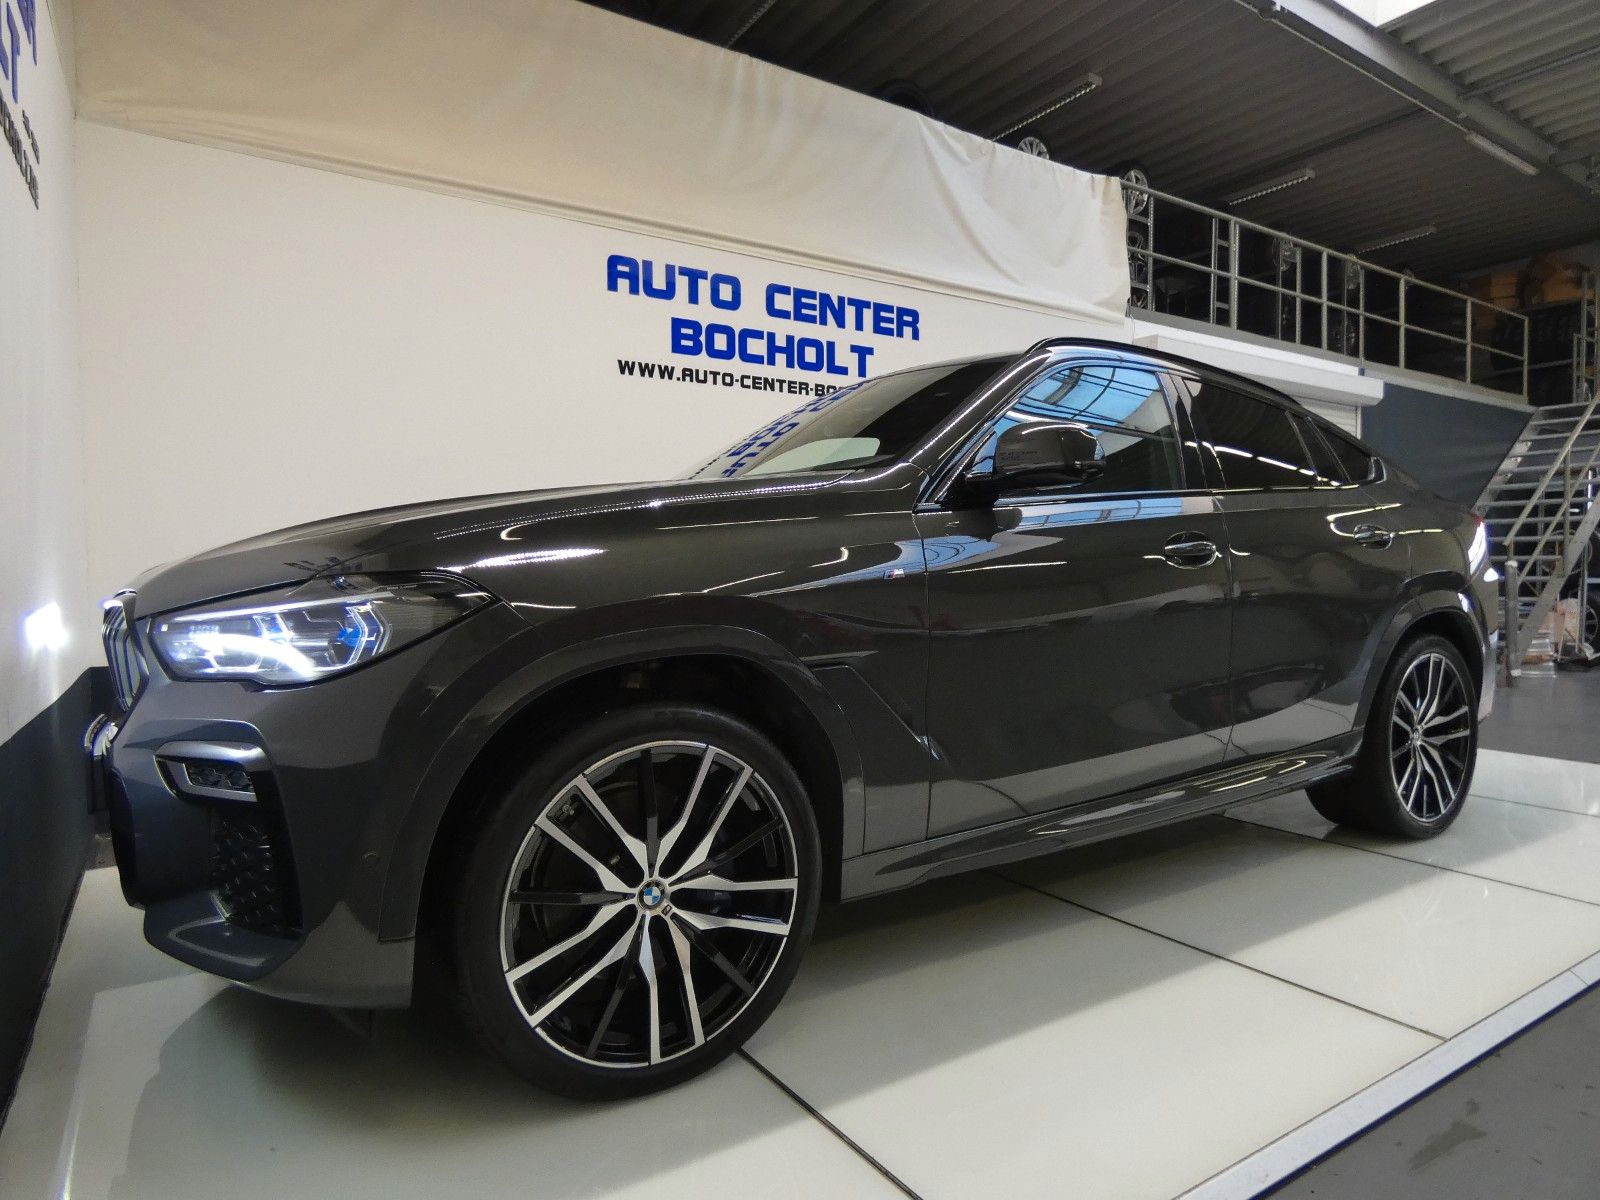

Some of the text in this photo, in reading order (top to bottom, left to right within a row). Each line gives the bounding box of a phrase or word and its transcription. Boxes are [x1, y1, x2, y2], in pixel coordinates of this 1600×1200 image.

[607, 254, 920, 341] AUTO CENTER
[617, 359, 845, 397] WWW.AUTO-CENTER-BO
[670, 316, 874, 378] BOCHOLT
